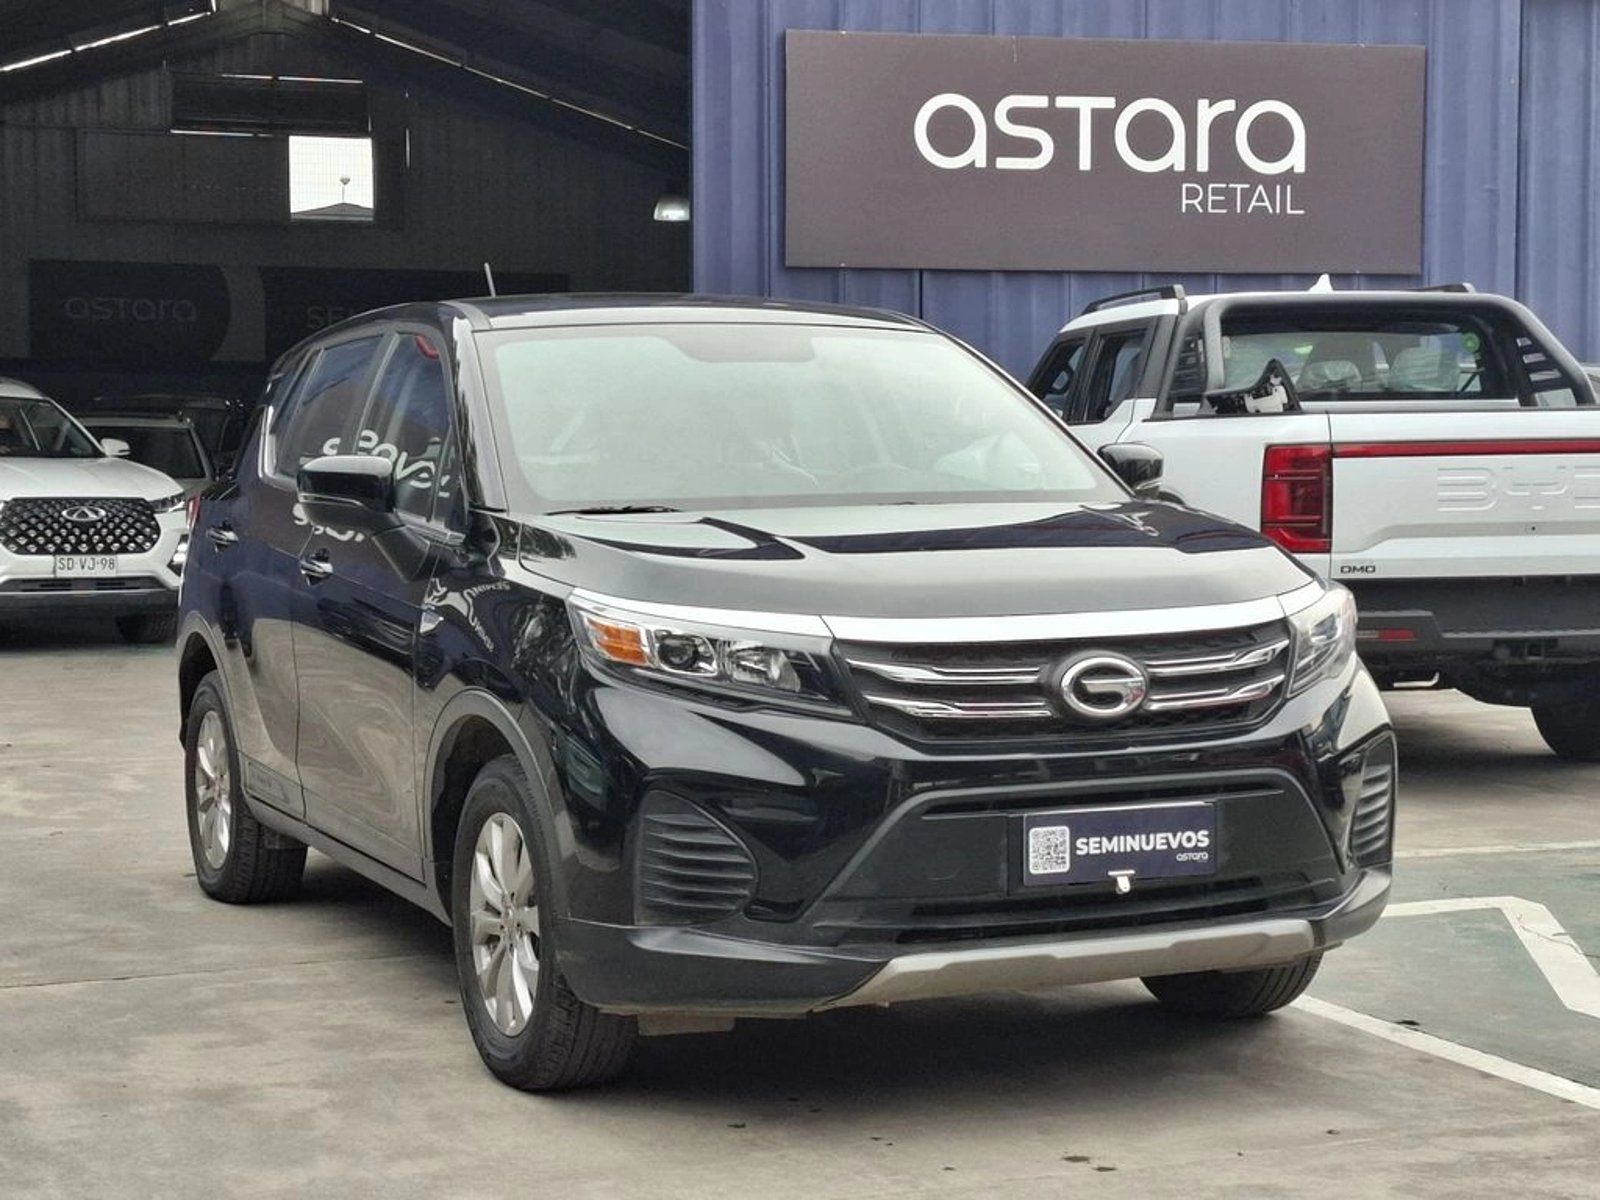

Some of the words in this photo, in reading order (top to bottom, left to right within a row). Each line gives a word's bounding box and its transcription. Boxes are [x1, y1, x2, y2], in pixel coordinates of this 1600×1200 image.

[914, 93, 1307, 175] astara
[1181, 183, 1306, 215] RETAIL
[58, 557, 74, 571] SD
[1075, 830, 1210, 856] SEMINUEVOS
